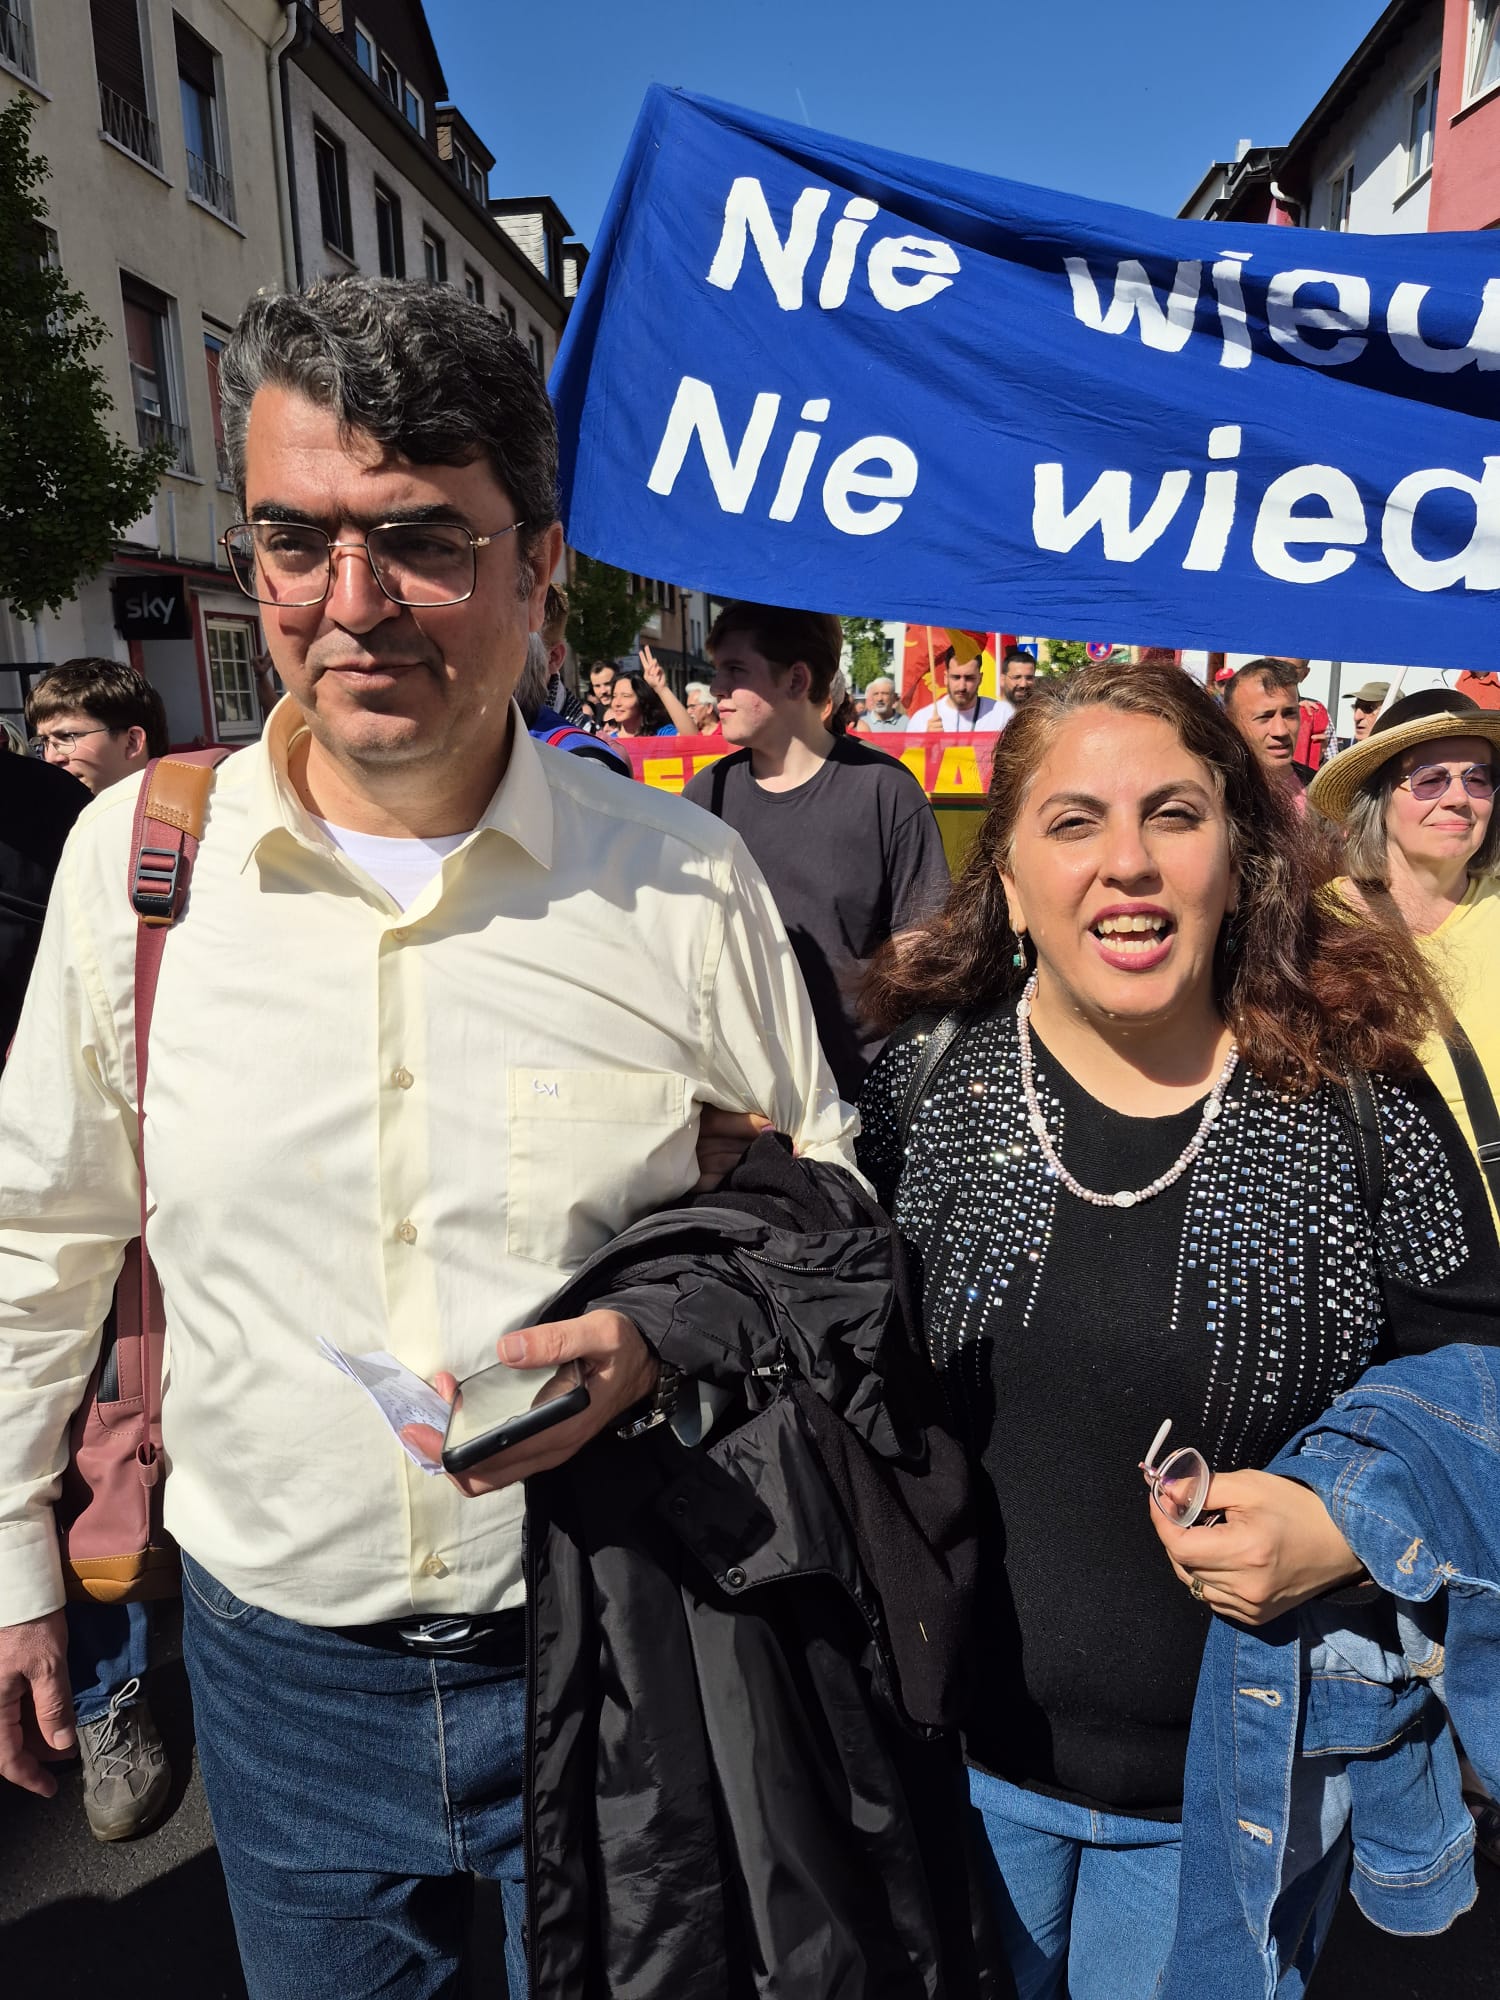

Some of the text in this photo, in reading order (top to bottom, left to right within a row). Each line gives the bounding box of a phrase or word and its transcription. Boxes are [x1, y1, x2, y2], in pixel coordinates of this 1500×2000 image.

[705, 176, 961, 312] Nie
[647, 375, 919, 536] Nie
[126, 592, 175, 624] sky
